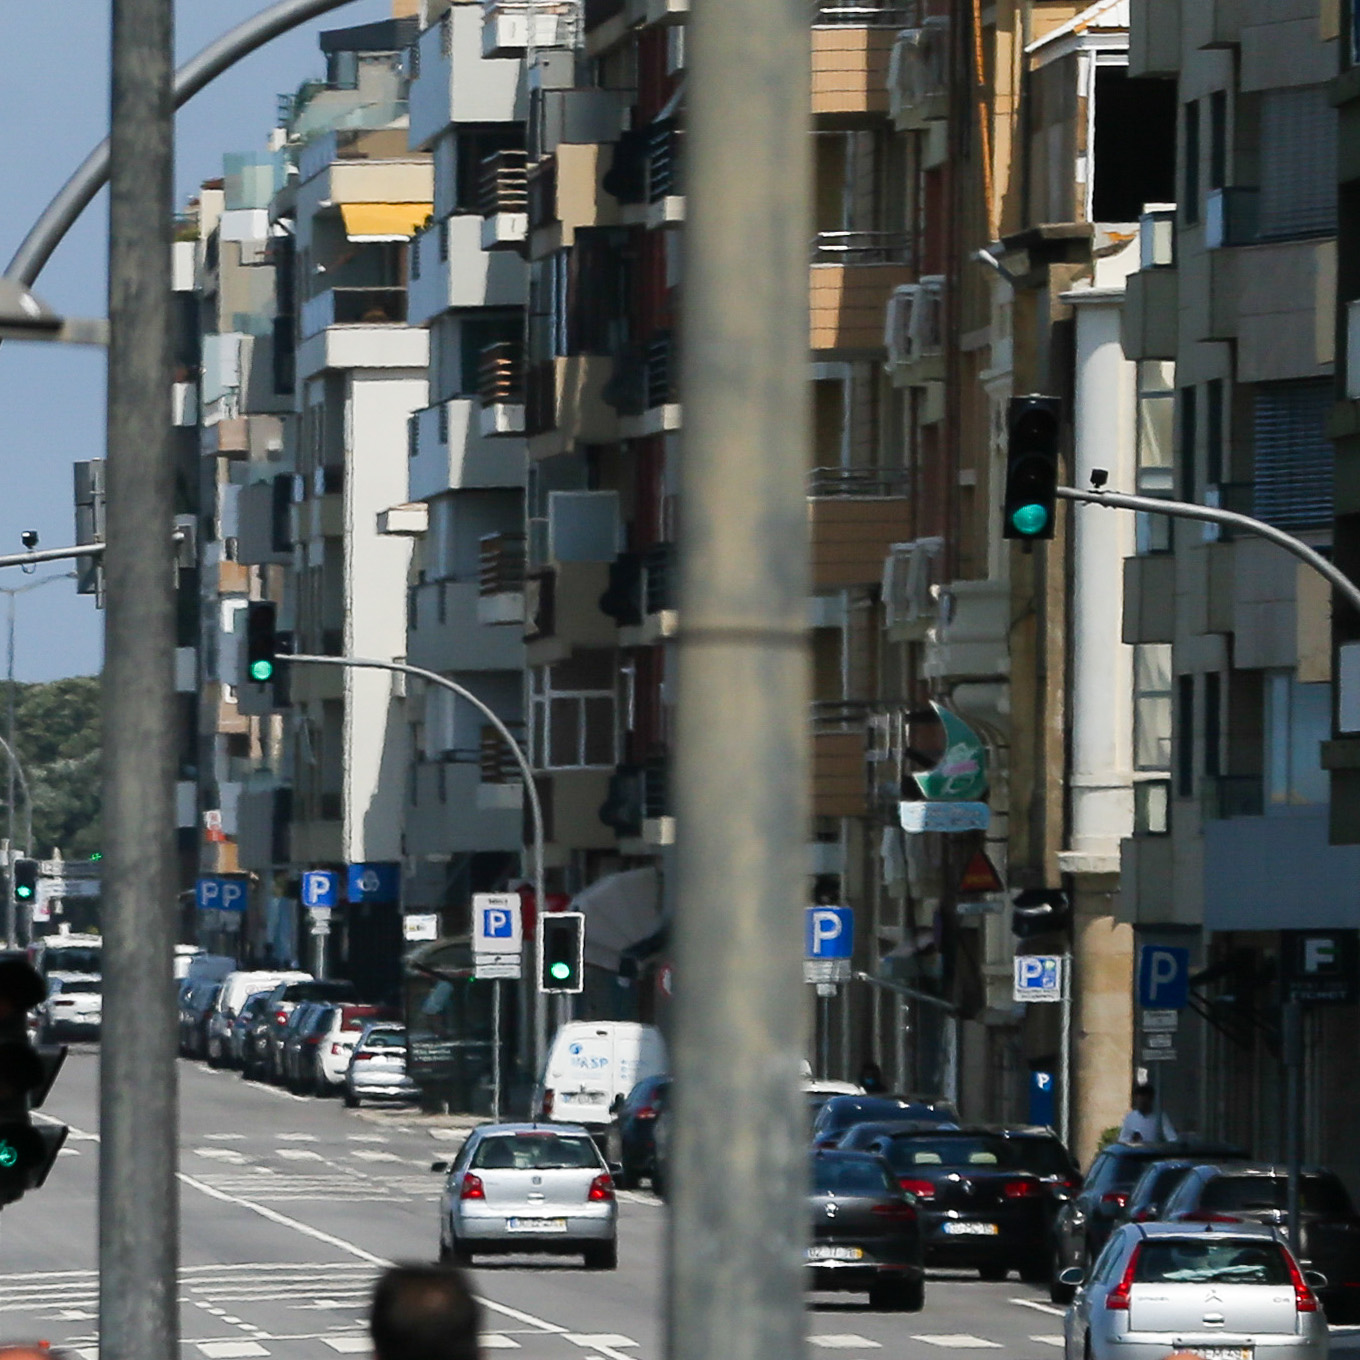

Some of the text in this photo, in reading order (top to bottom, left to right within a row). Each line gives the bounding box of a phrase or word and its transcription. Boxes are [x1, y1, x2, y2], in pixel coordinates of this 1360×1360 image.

[201, 882, 241, 907] P P
[308, 874, 330, 903] P
[489, 911, 506, 936] P
[813, 911, 842, 954] P
[1305, 938, 1335, 972] F
[1022, 958, 1043, 987] P
[1149, 951, 1178, 1000] P
[1037, 1073, 1050, 1088] P
